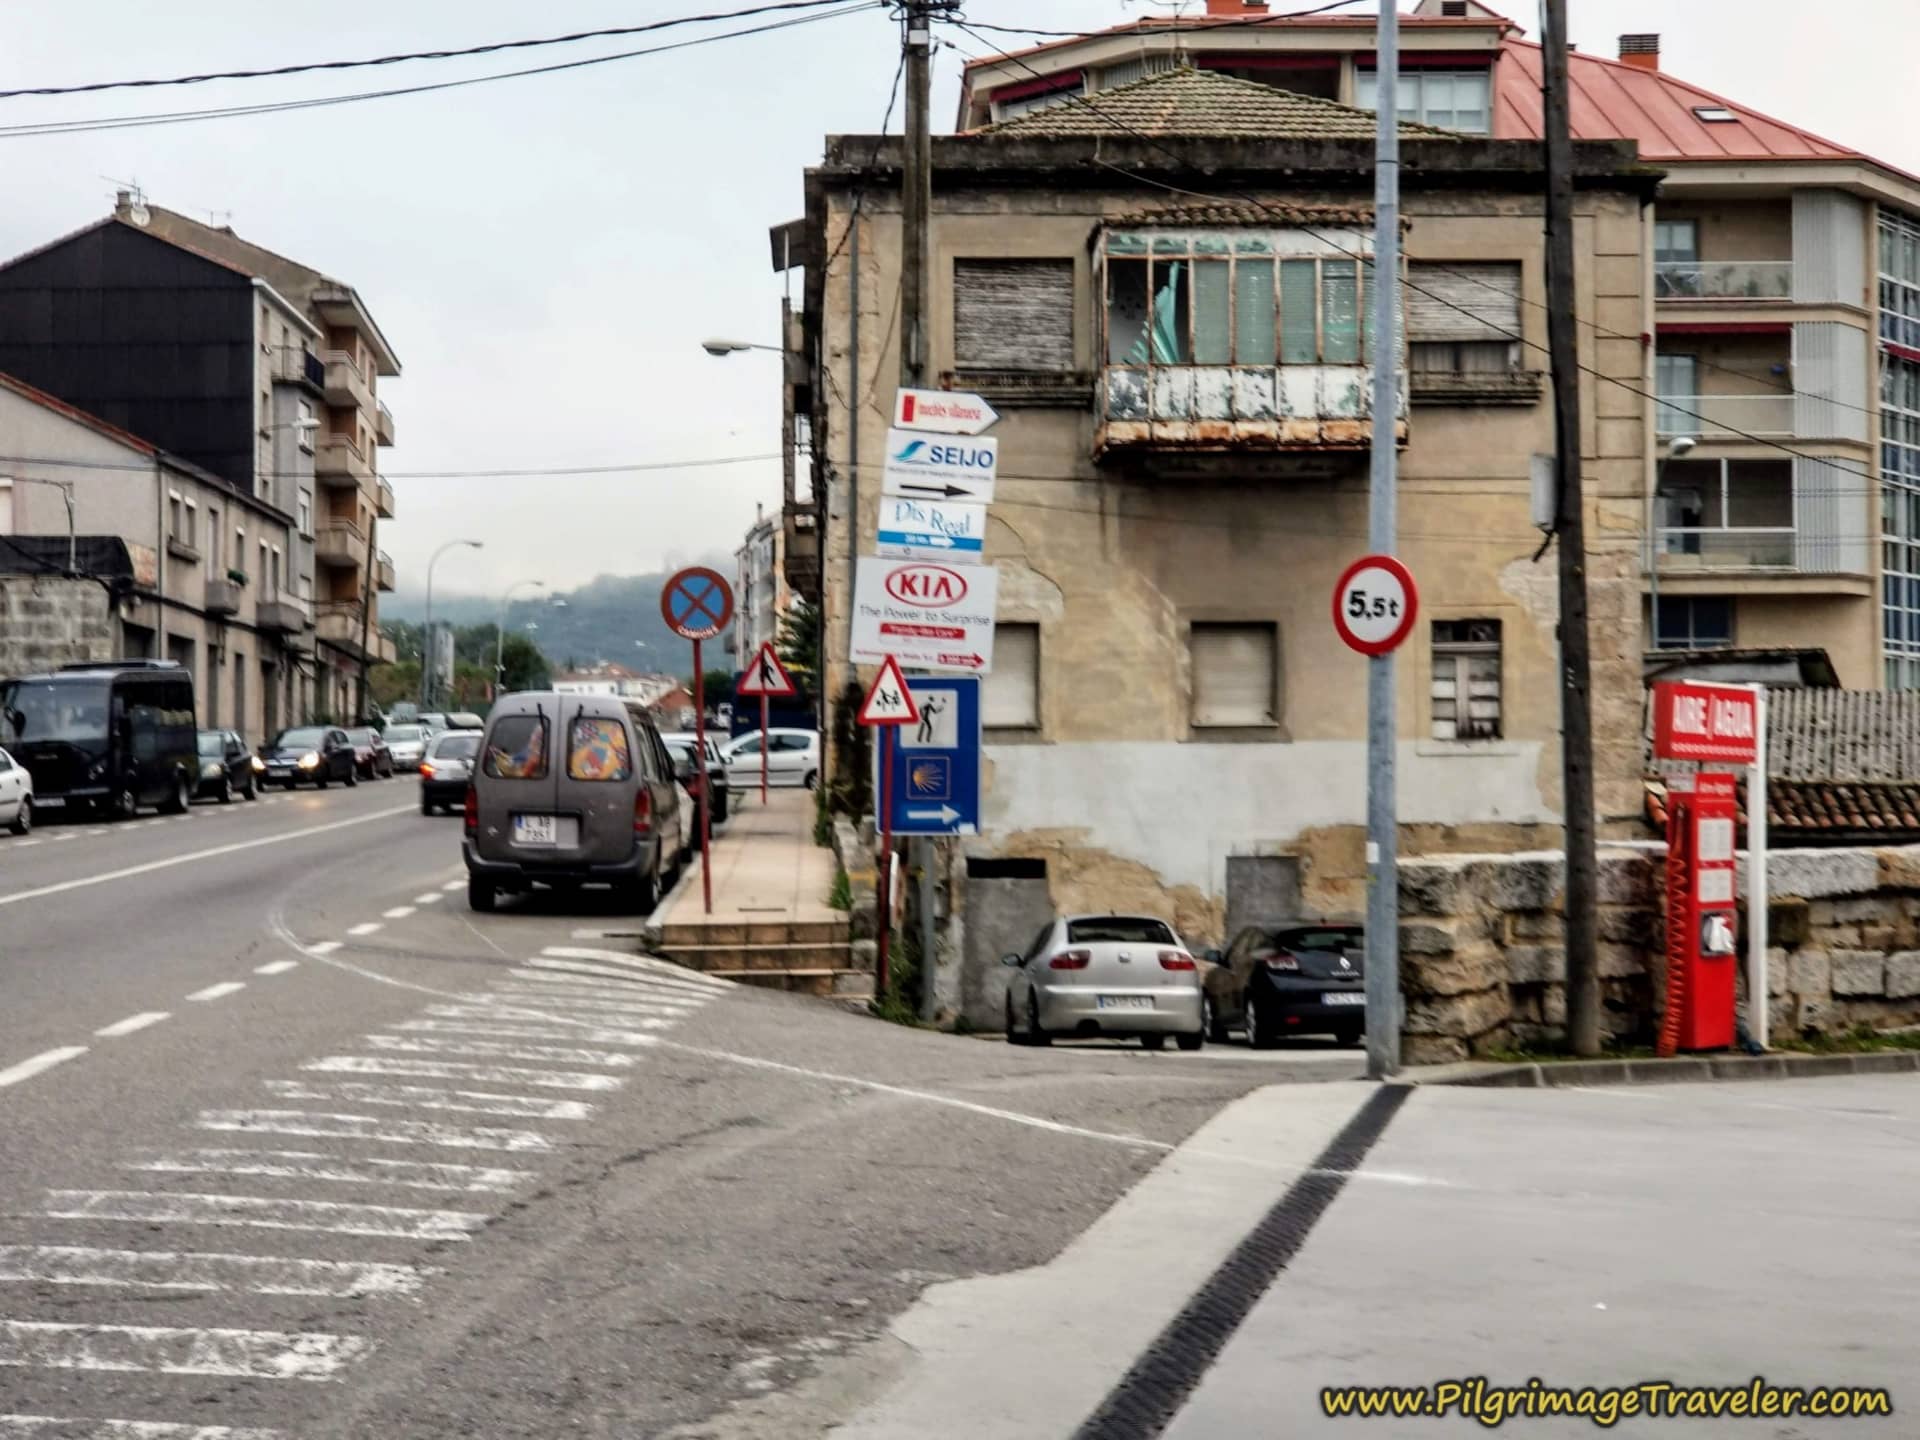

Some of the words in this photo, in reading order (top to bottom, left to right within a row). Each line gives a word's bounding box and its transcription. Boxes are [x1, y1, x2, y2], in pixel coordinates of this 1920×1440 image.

[930, 445, 994, 468] SEIJO
[931, 507, 970, 537] Real
[899, 573, 953, 601] KIA
[859, 604, 881, 617] The
[884, 606, 919, 620] Power
[924, 610, 939, 621] to
[940, 611, 990, 626] Surprise
